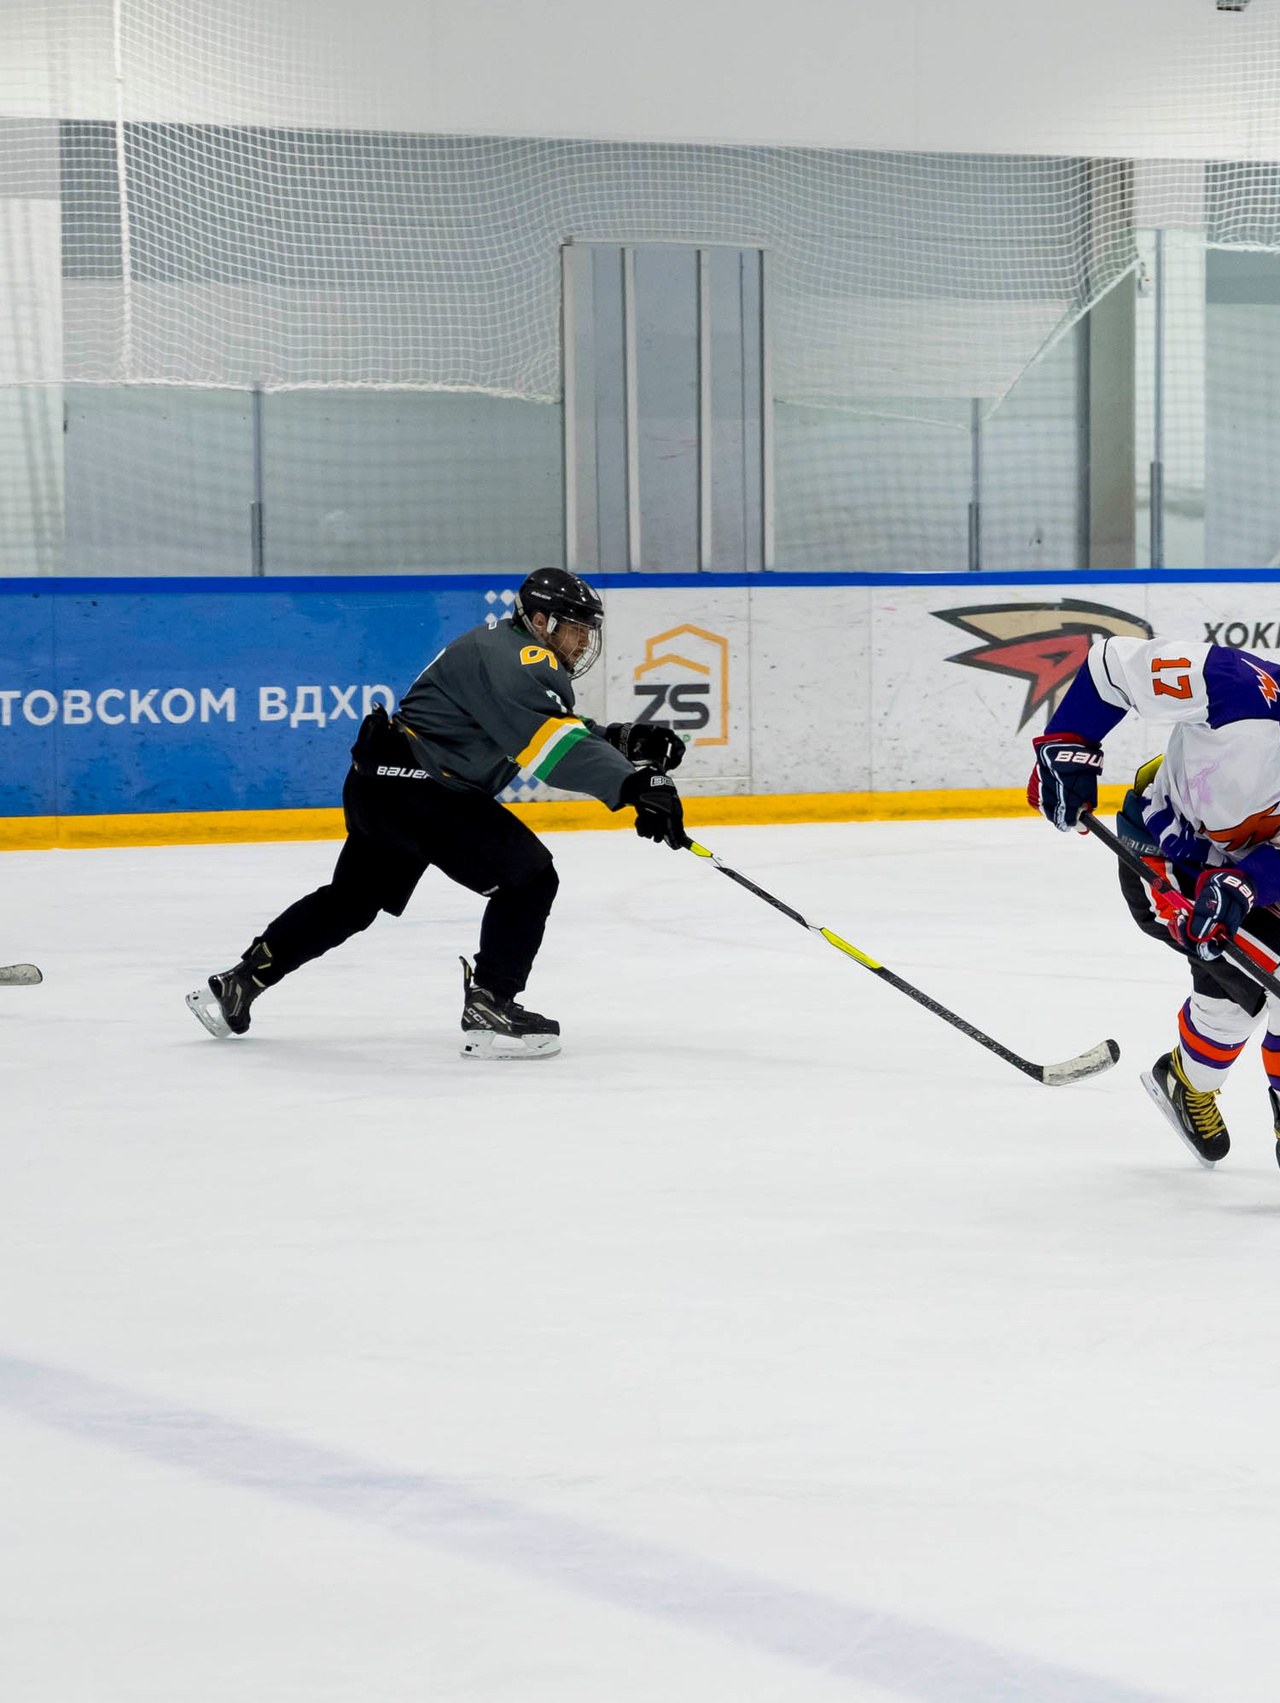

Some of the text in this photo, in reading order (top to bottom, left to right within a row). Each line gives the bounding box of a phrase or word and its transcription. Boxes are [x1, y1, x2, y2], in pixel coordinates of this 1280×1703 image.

[1151, 657, 1193, 699] 17
[0, 687, 236, 726] ТОВСКОМ
[634, 683, 710, 730] ZS
[466, 1007, 493, 1029] CCM
